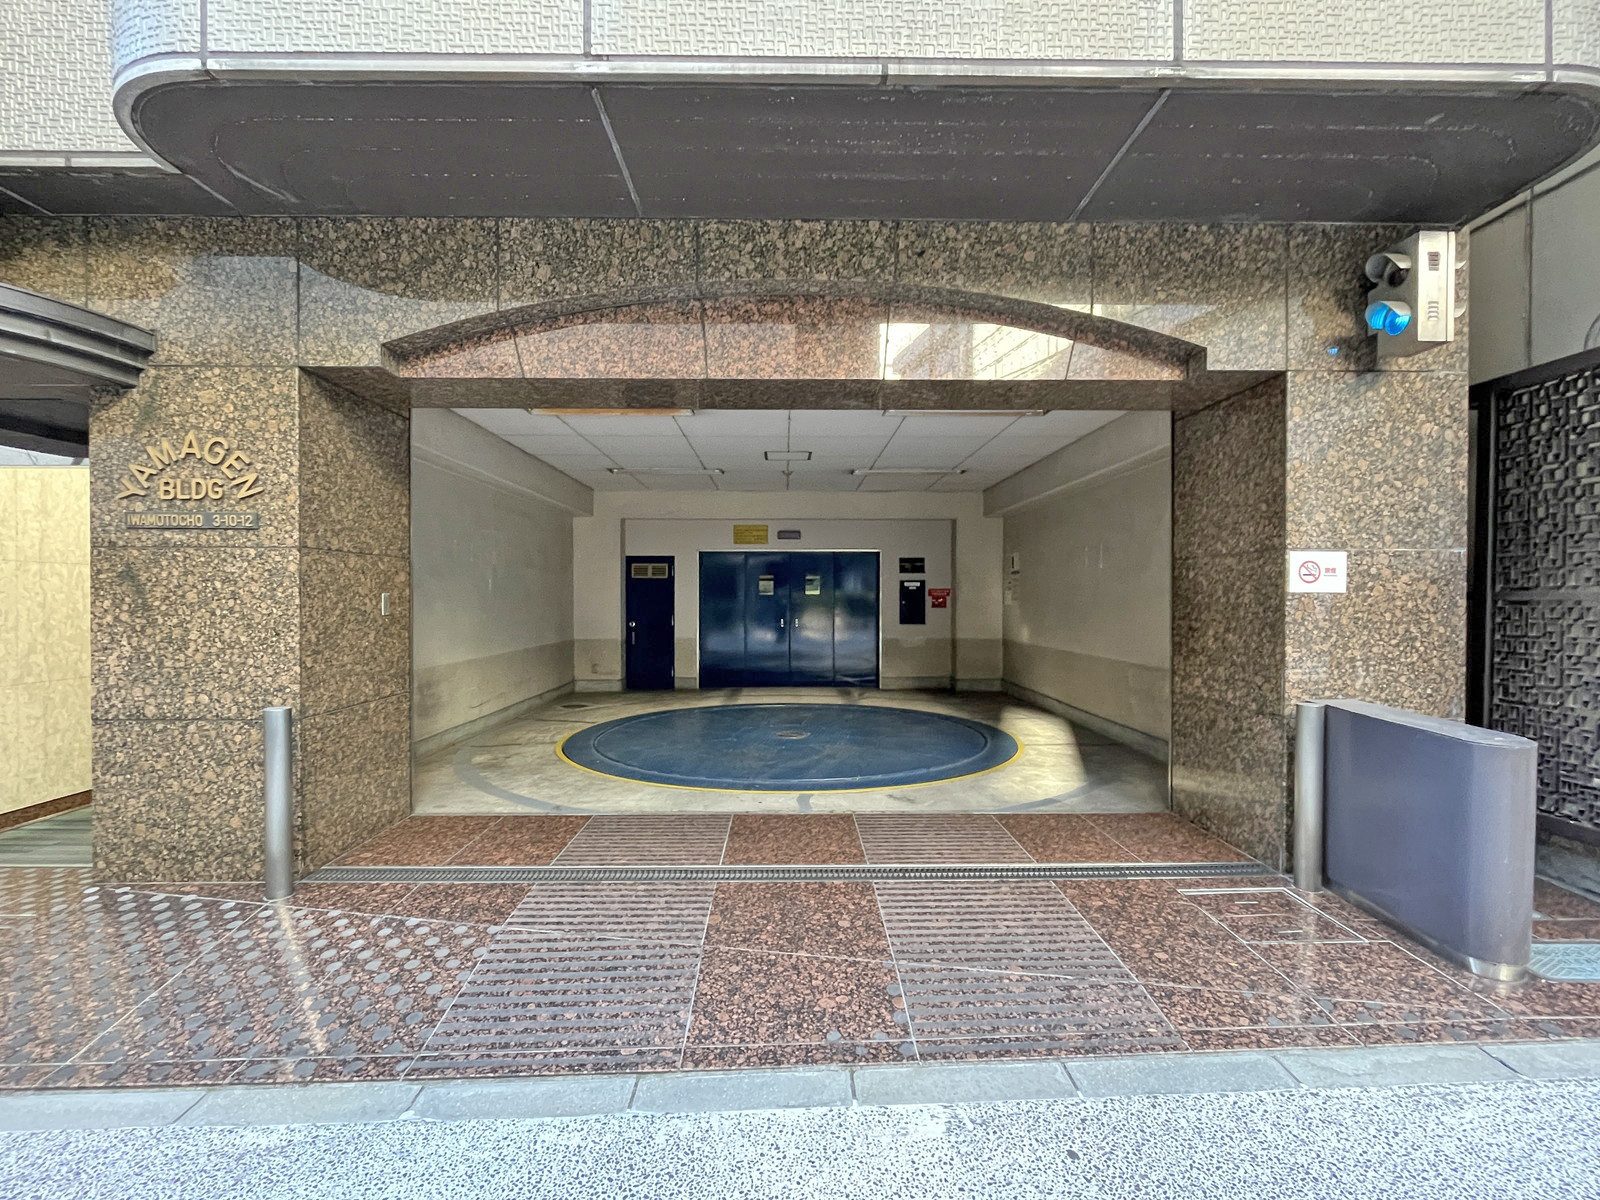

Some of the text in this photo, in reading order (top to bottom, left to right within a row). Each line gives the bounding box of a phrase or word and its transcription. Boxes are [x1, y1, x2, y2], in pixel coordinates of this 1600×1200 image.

[116, 430, 264, 499] YAMAGEN
[159, 478, 224, 500] BLDG
[127, 514, 253, 527] IWAMOTOCHO 3-10-12
